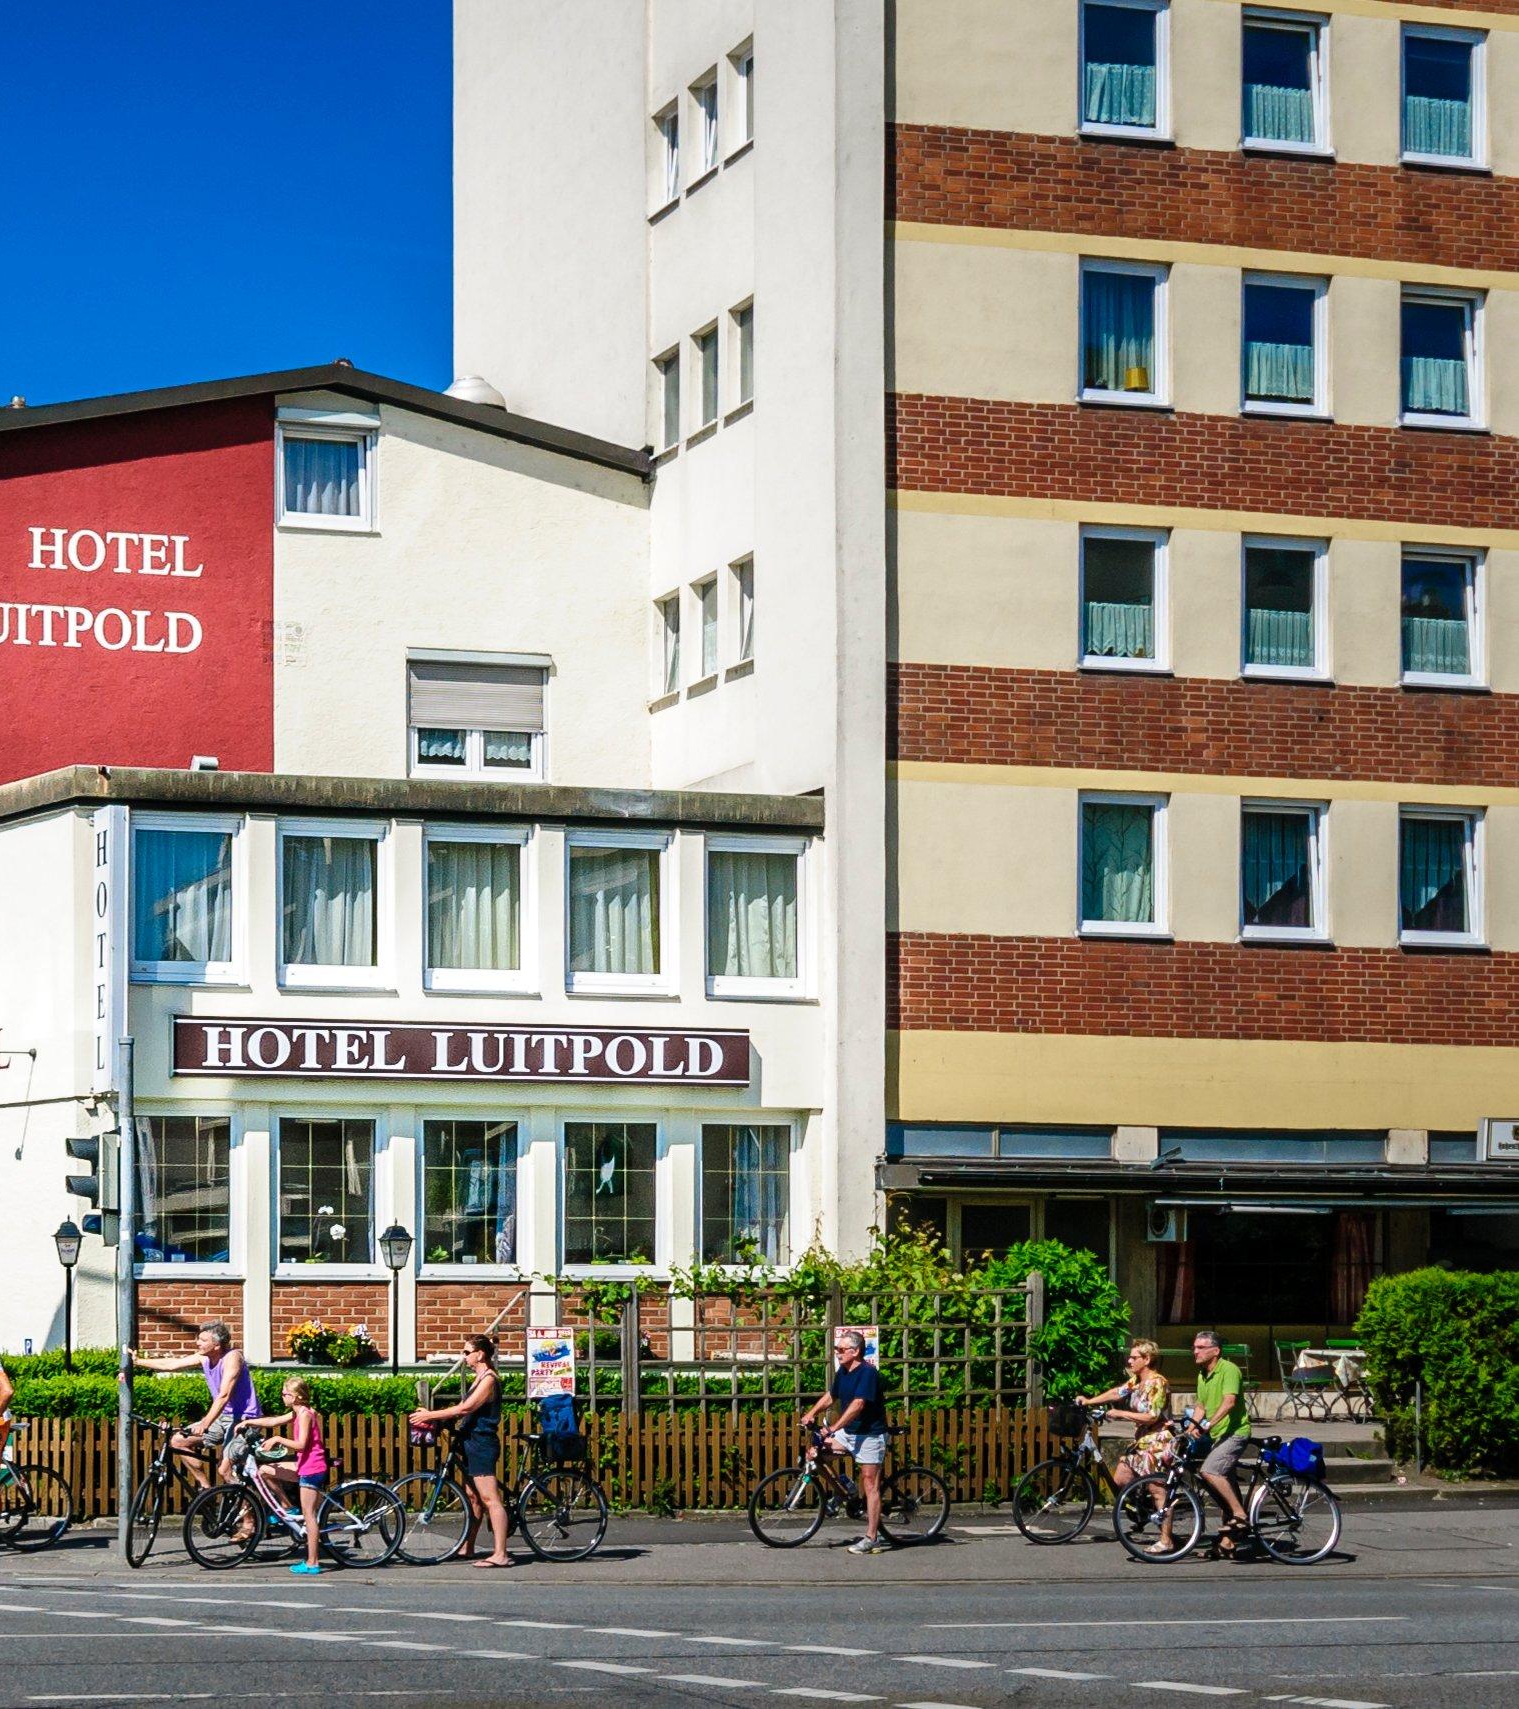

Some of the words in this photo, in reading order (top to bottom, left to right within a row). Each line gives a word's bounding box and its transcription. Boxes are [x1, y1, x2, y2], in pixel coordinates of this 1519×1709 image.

[27, 526, 204, 578] HOTEL
[96, 829, 108, 1071] HOTEL
[201, 1026, 407, 1070] HOTEL
[431, 1030, 724, 1076] LUITPOLD
